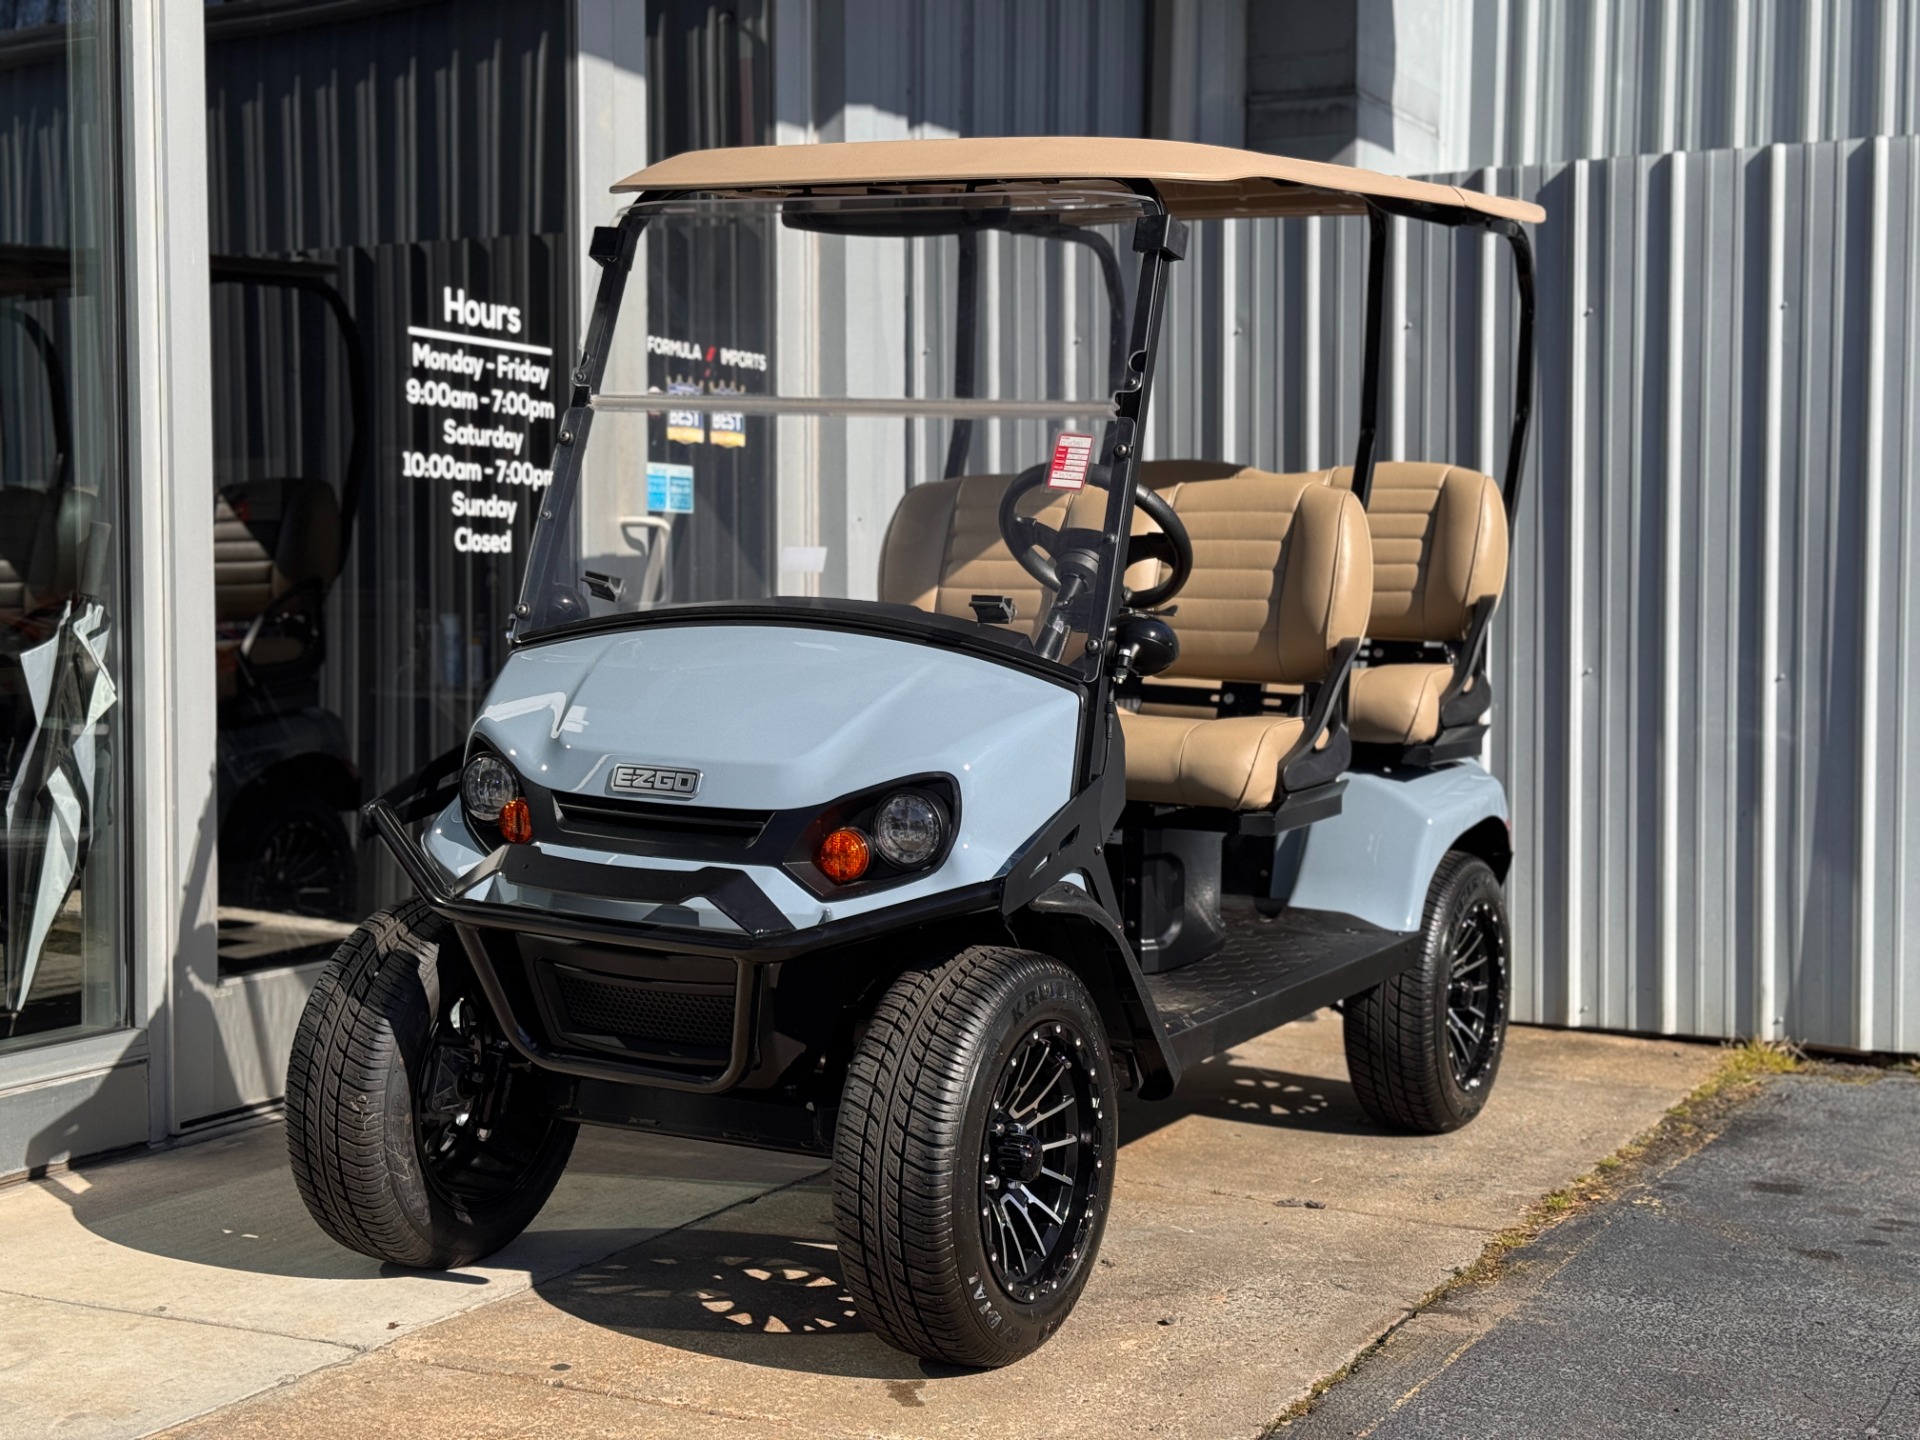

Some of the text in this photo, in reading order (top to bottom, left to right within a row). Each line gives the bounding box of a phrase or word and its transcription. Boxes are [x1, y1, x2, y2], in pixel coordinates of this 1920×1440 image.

[443, 286, 522, 334] Hours
[647, 336, 703, 362] FORMULA
[412, 341, 484, 382] Monday
[496, 354, 550, 391] Friday
[405, 377, 479, 411] 9:00am
[490, 388, 556, 423] 7:00pm
[669, 410, 700, 427] BEST
[711, 411, 743, 431] BEST
[442, 418, 525, 456] Saturday
[402, 450, 483, 482] 10:00am
[451, 490, 518, 525] Sunday
[453, 526, 513, 554] Closed
